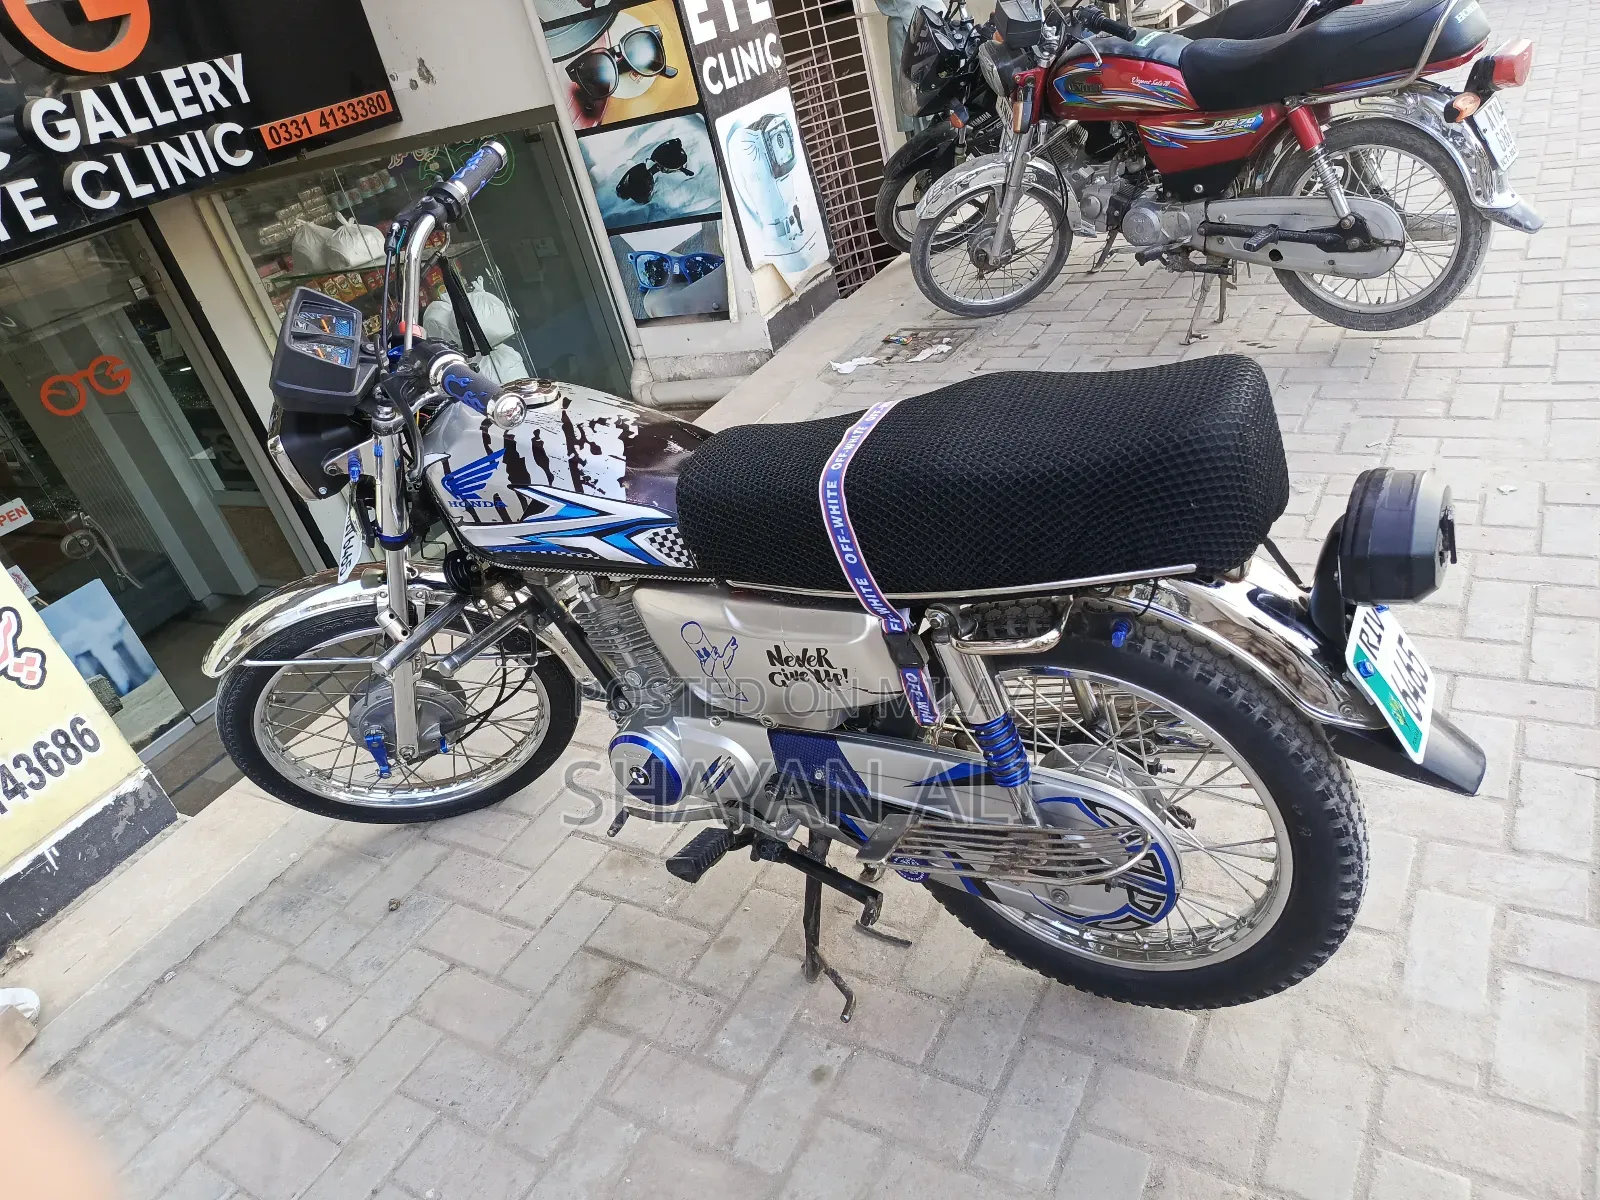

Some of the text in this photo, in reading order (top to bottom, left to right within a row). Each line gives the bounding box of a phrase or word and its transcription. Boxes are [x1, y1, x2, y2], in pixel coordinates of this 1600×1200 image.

[30, 53, 251, 153] GALLERY
[703, 33, 782, 95] CLINIC
[268, 94, 388, 146] 0331 4133380
[72, 122, 254, 210] CLINIC
[831, 425, 868, 471] OFF-WHITE
[826, 480, 858, 564] OFF-WHITE
[768, 668, 810, 688] Give
[1391, 634, 1429, 722] 6465
[0, 716, 101, 815] 43686
